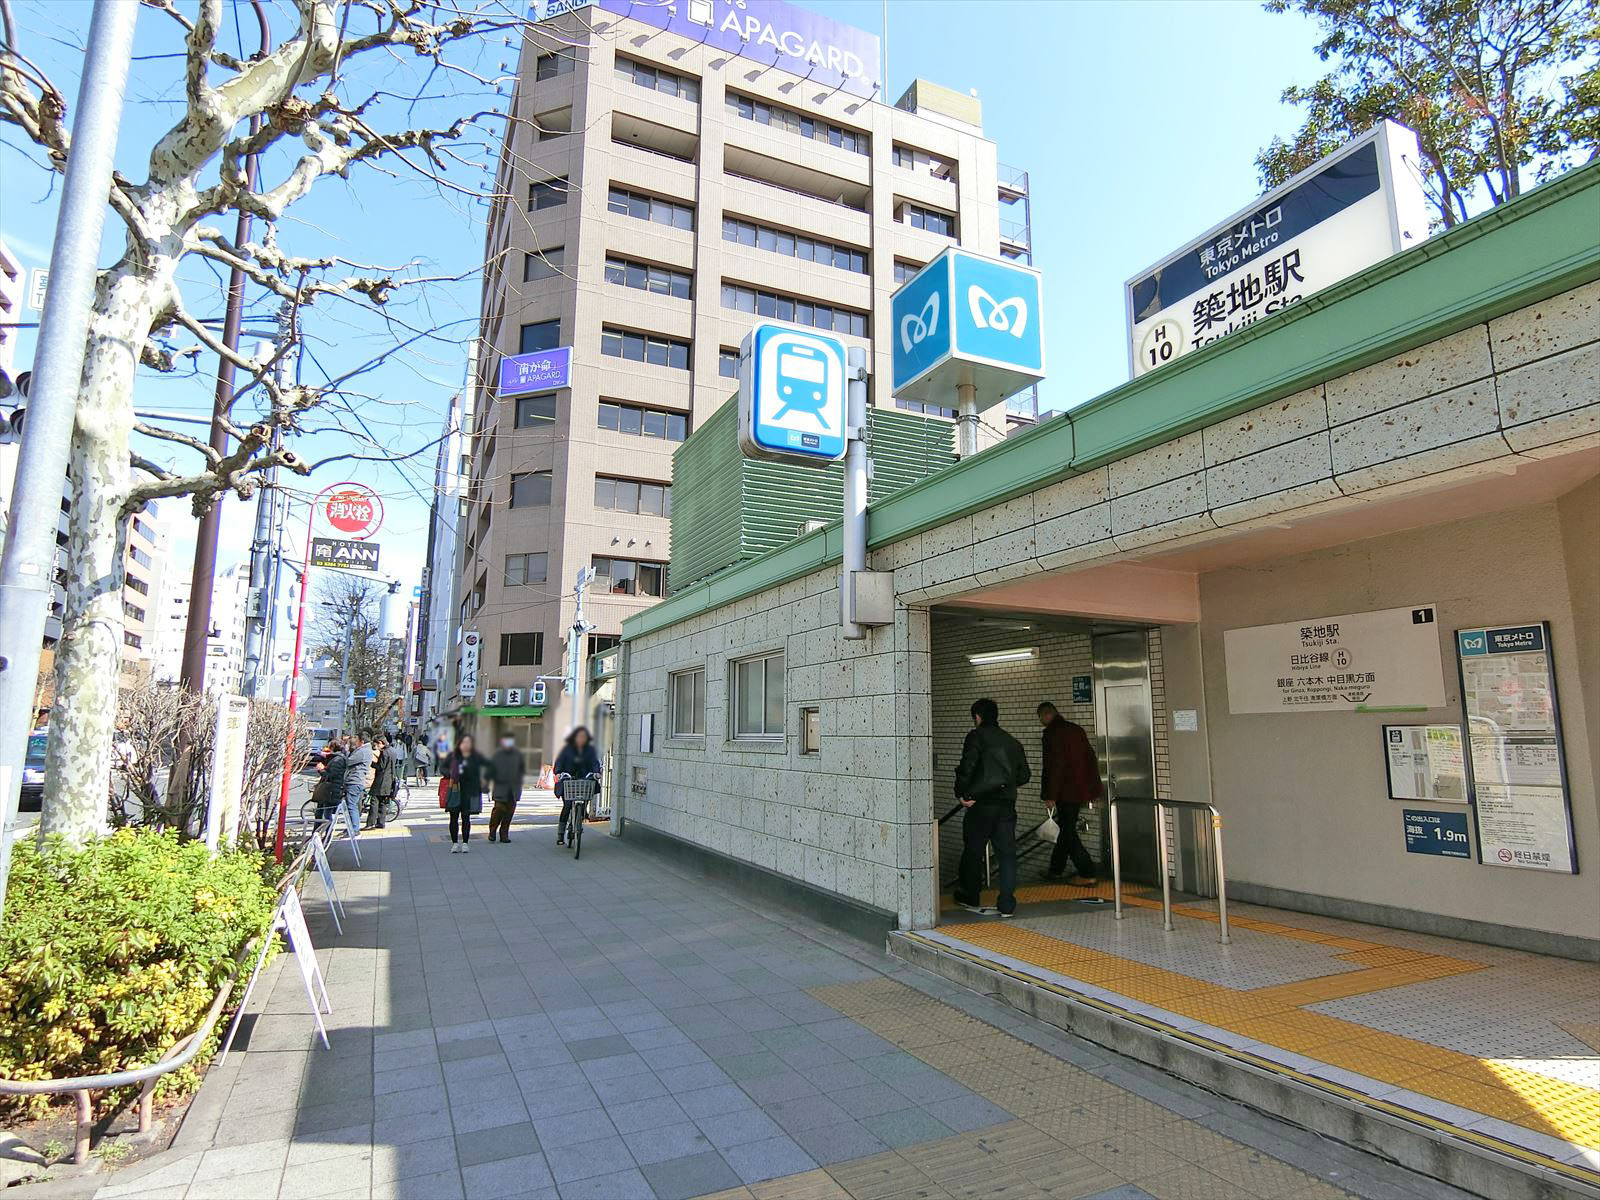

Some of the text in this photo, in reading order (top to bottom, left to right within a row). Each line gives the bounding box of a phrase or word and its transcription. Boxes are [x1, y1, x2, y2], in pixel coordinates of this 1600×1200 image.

[1199, 205, 1283, 267] 東京メトロ
[1205, 230, 1279, 279] Tokyo Metro
[1191, 248, 1305, 337] 築地駅
[1154, 325, 1166, 343] H
[1149, 341, 1173, 367] 10
[334, 547, 378, 562] ANN
[1418, 610, 1426, 622] 1
[1300, 623, 1340, 640] 築地駅
[1494, 632, 1534, 643] 東京メトロ
[1301, 640, 1324, 648] Tsukiji
[1290, 652, 1329, 665] 日比谷線
[1296, 676, 1324, 687] 六本木
[1326, 672, 1376, 684] 中目黒方面
[1405, 814, 1441, 824] この出入口は
[1433, 827, 1467, 843] 1.9m
[1514, 850, 1551, 862] 終日禁煙
